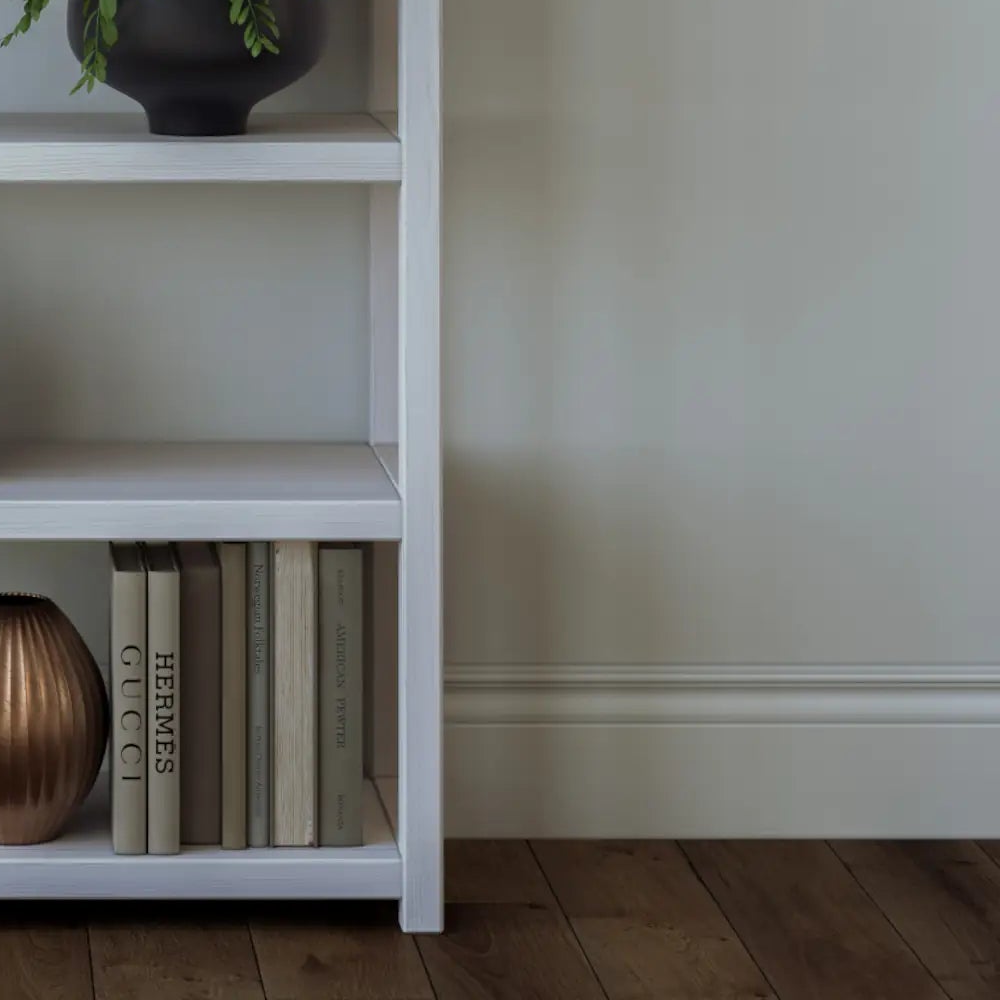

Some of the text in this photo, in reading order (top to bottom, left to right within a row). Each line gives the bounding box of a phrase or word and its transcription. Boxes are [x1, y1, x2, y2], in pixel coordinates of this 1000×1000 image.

[335, 623, 347, 688] AMERICAN
[120, 645, 142, 781] GUCCI
[335, 697, 347, 749] PEWTER
